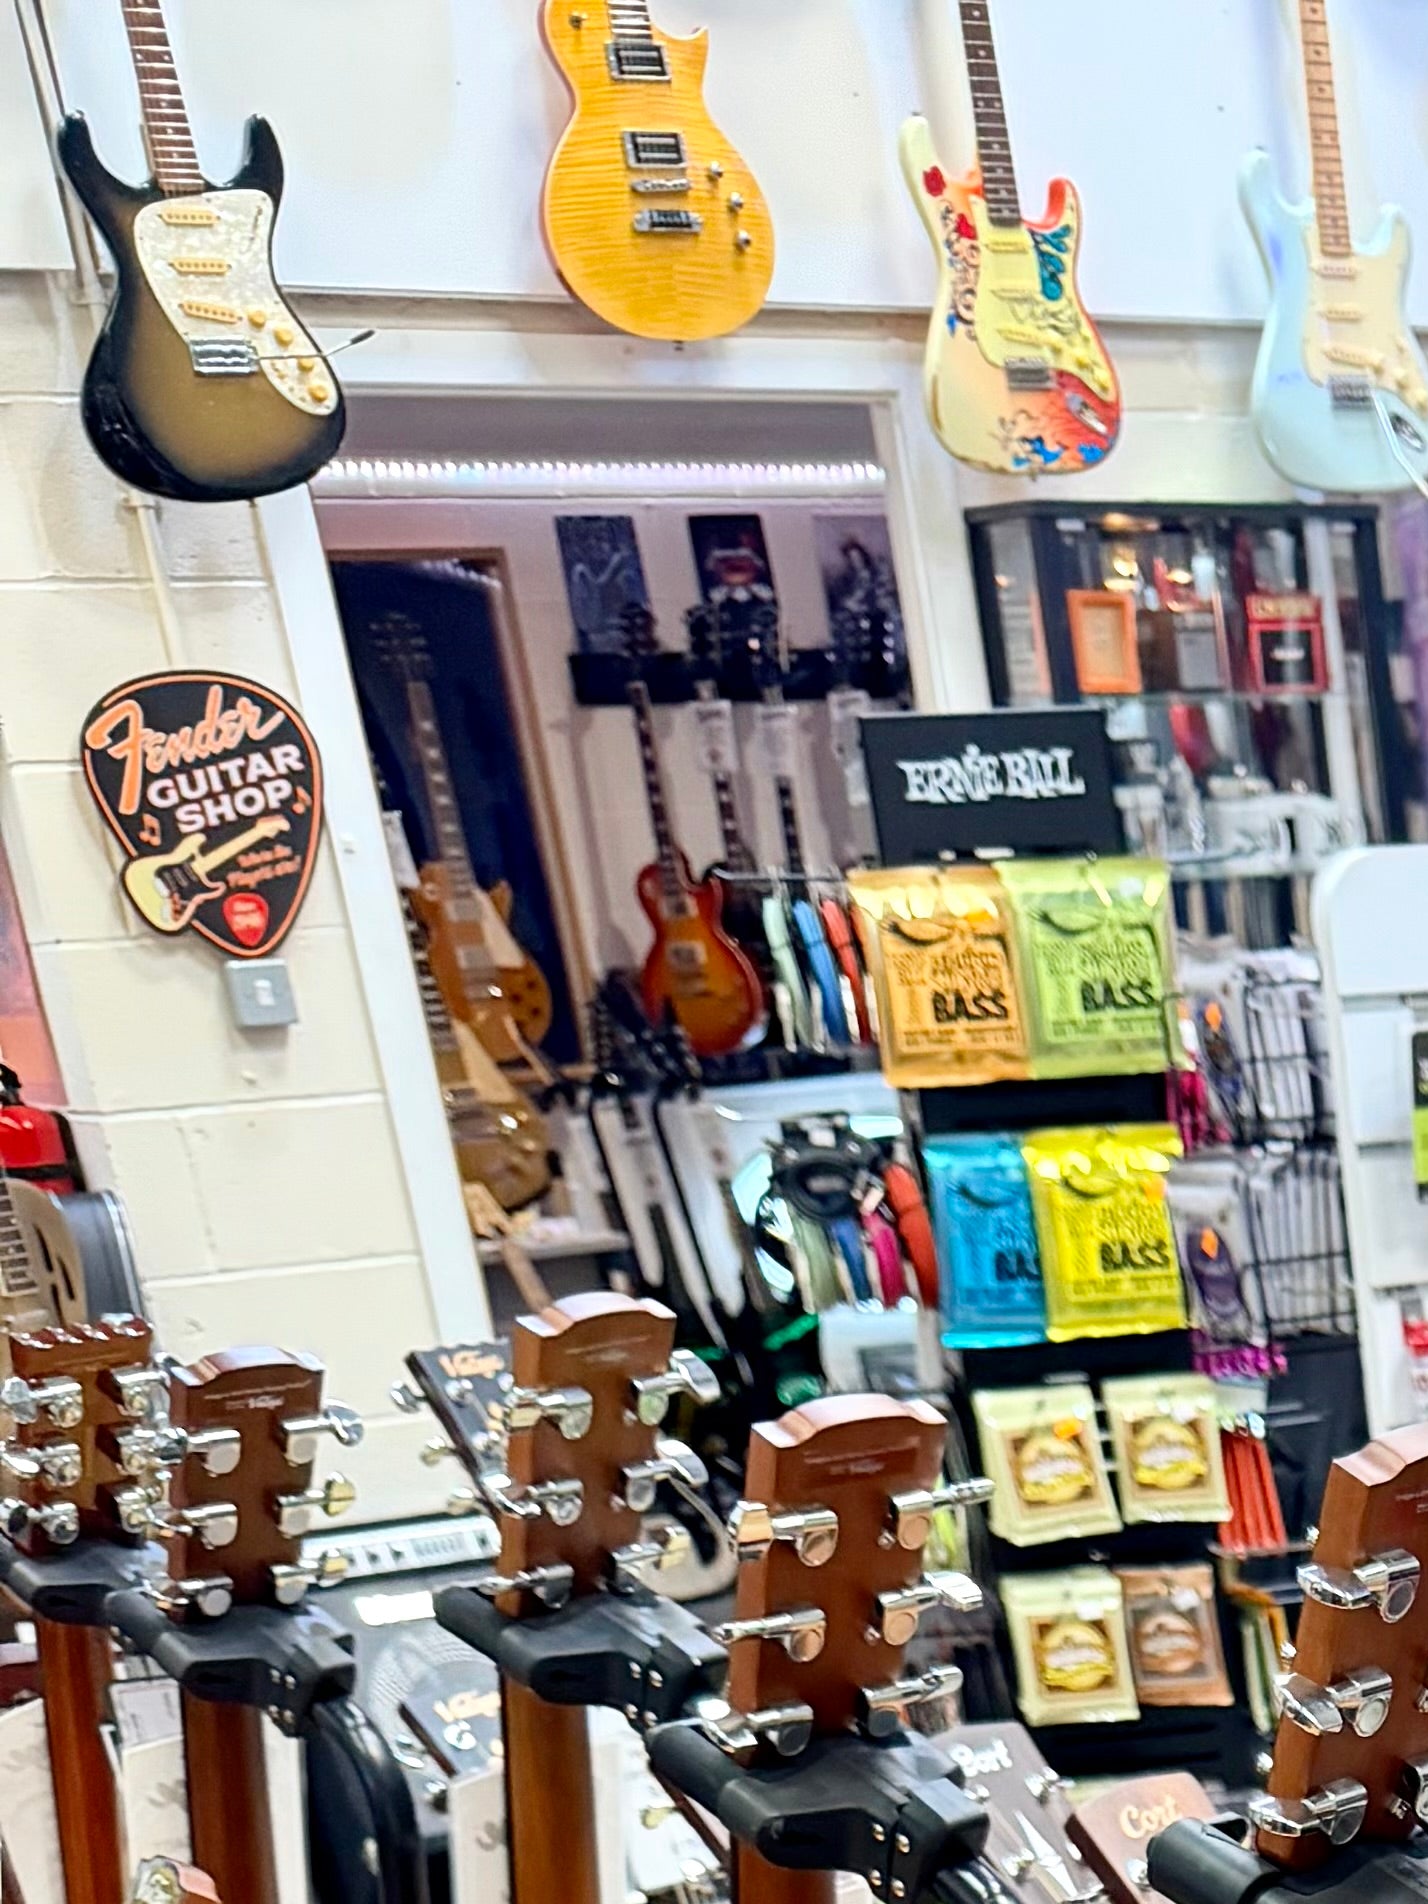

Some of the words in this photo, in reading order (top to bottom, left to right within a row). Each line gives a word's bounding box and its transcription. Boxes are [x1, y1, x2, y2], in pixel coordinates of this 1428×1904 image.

[85, 684, 287, 815] Fender
[896, 743, 1002, 803] ERNIE
[1001, 747, 1086, 800] BALL
[147, 744, 305, 809] GUITAR
[175, 778, 293, 834] SHOP
[932, 988, 1010, 1024] BASS
[1080, 979, 1157, 1013] BASS
[1100, 1239, 1171, 1273] BASS
[1119, 1794, 1182, 1840] Cort
